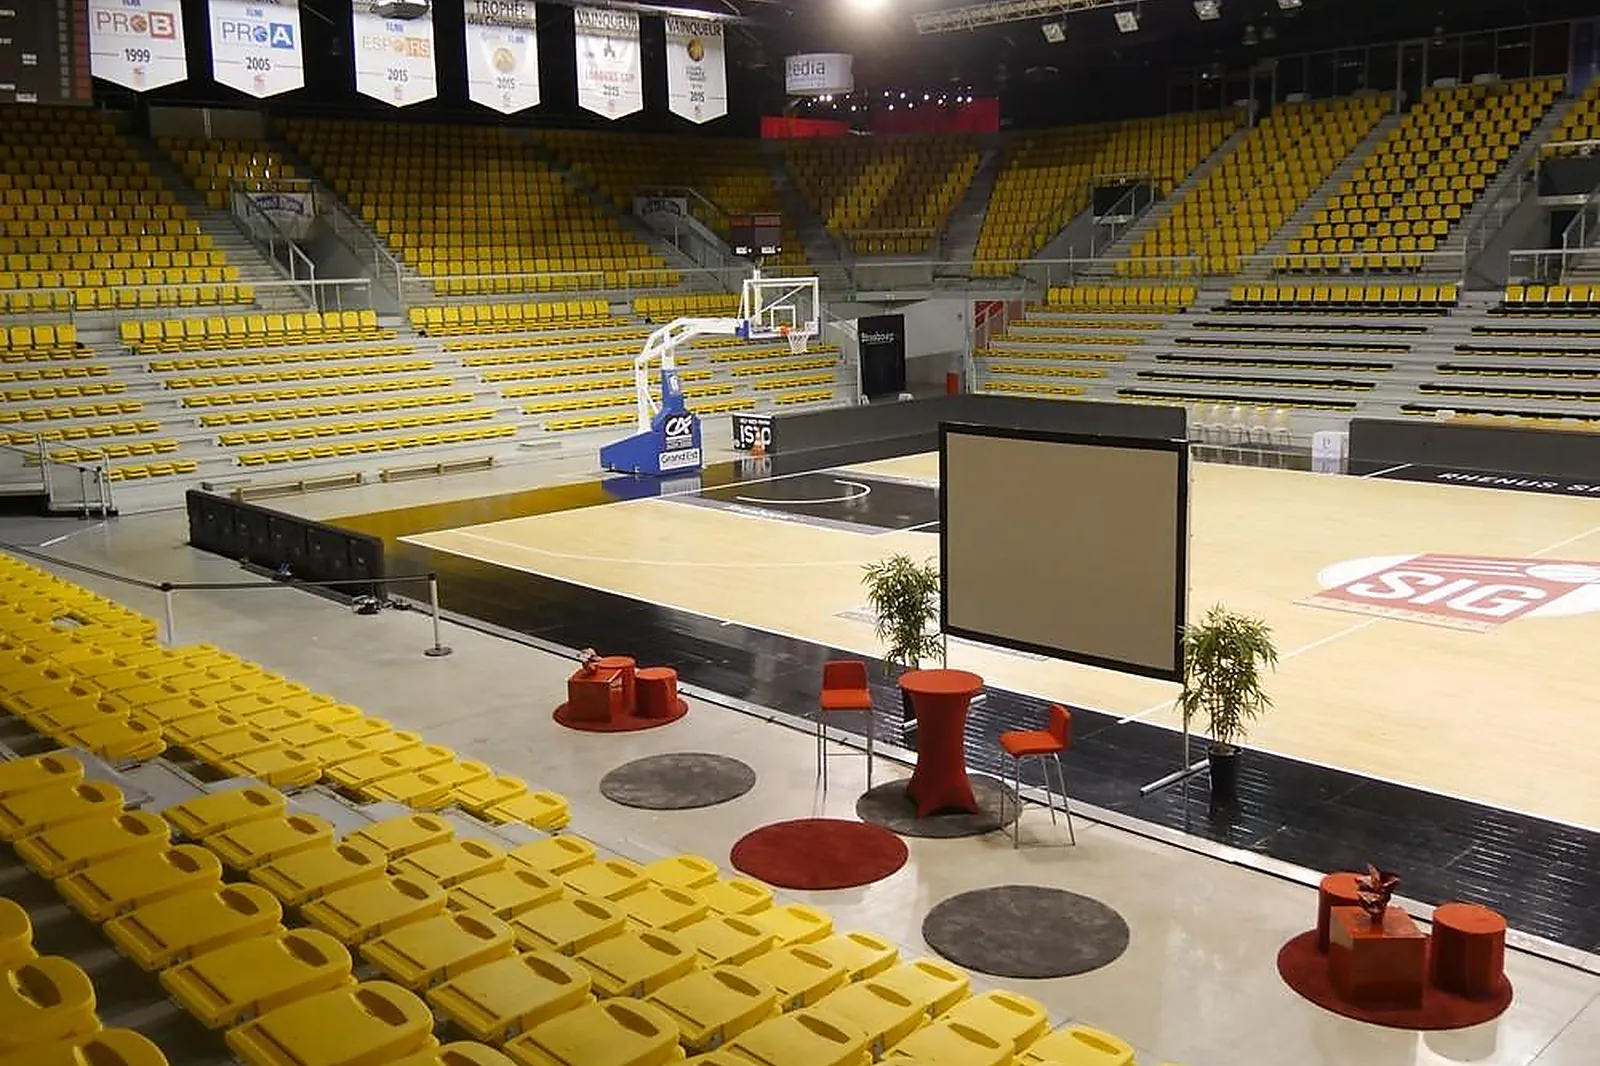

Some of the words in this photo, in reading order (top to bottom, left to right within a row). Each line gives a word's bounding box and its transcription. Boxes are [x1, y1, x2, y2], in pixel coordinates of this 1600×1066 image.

[577, 10, 640, 32] VAINQUEUR
[667, 18, 724, 37] VAINQUEUR
[126, 48, 151, 63] 1999
[246, 56, 272, 71] 2005
[387, 67, 409, 82] 2015
[496, 77, 516, 90] 2015
[689, 91, 706, 103] 2015
[1436, 472, 1559, 488] RHENUS
[1346, 570, 1548, 618] SIG
